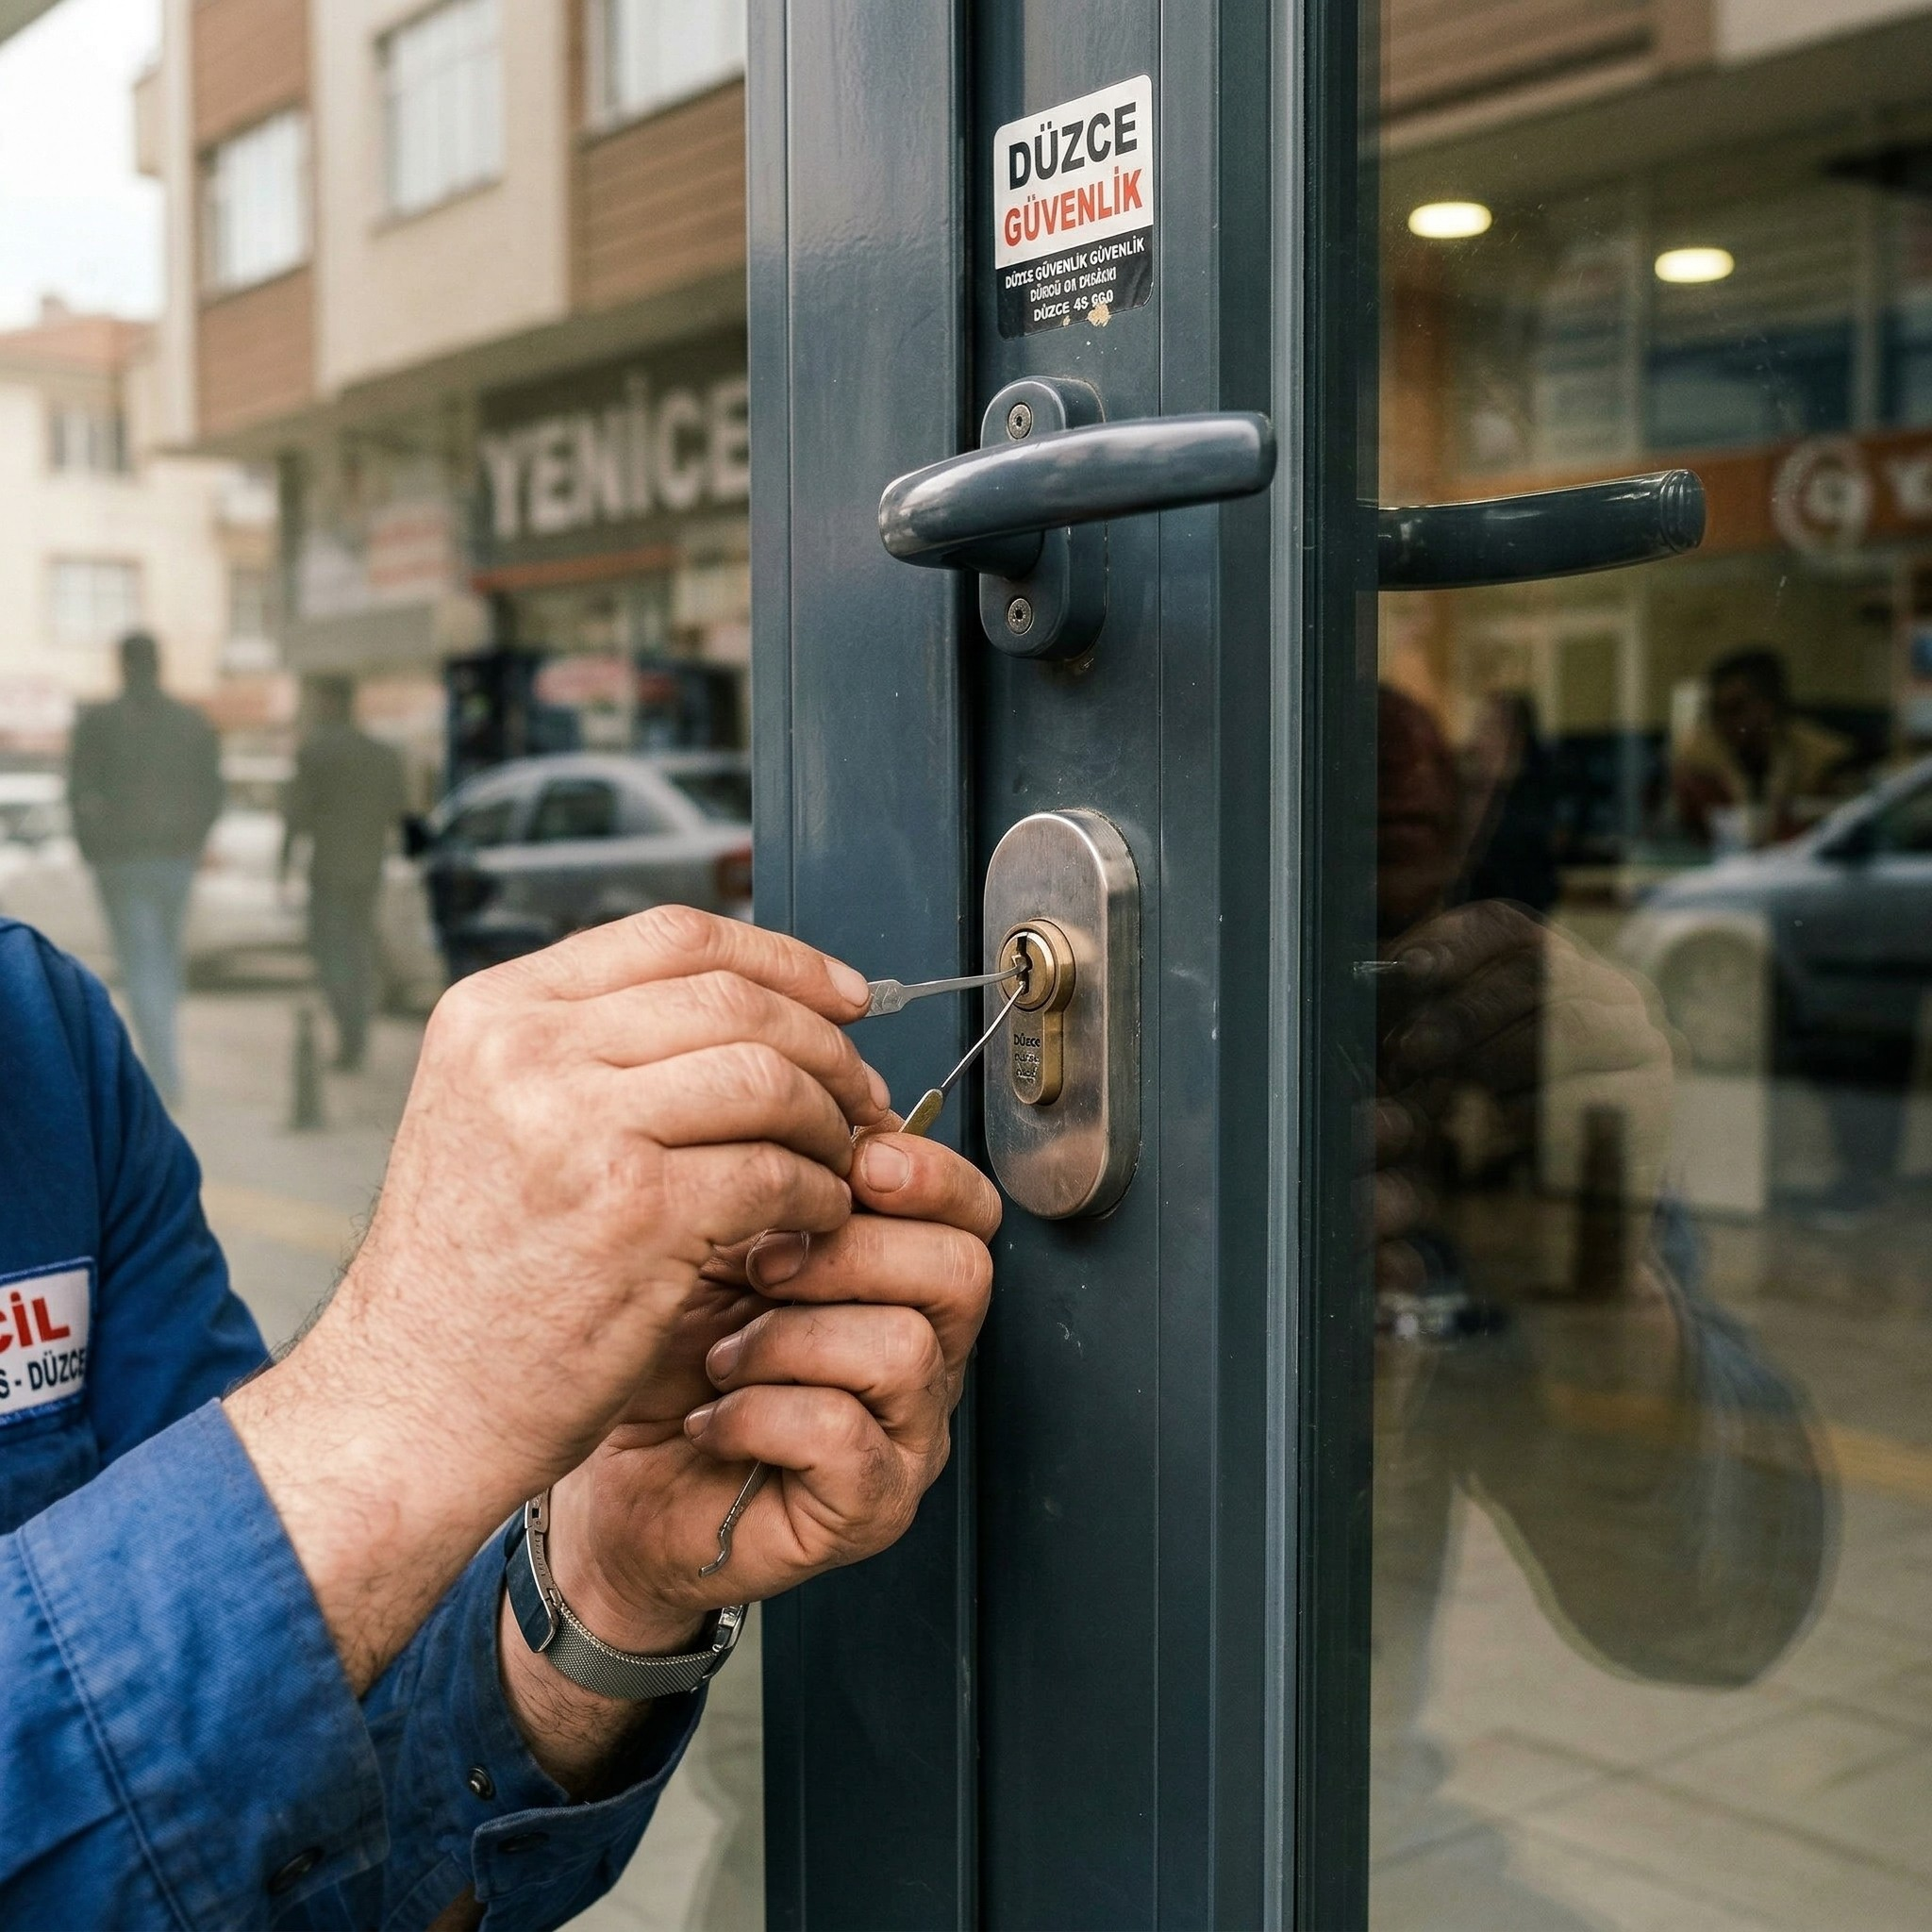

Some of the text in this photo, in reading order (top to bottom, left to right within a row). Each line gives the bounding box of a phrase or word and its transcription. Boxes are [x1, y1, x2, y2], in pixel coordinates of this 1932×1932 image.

[1008, 101, 1138, 191] DÜZCE
[1004, 165, 1143, 247] GÜVENLİK
[1090, 236, 1144, 265] GÜVENLİK
[1033, 301, 1071, 322] DÜZCE
[27, 1349, 86, 1391] DÜZCE
